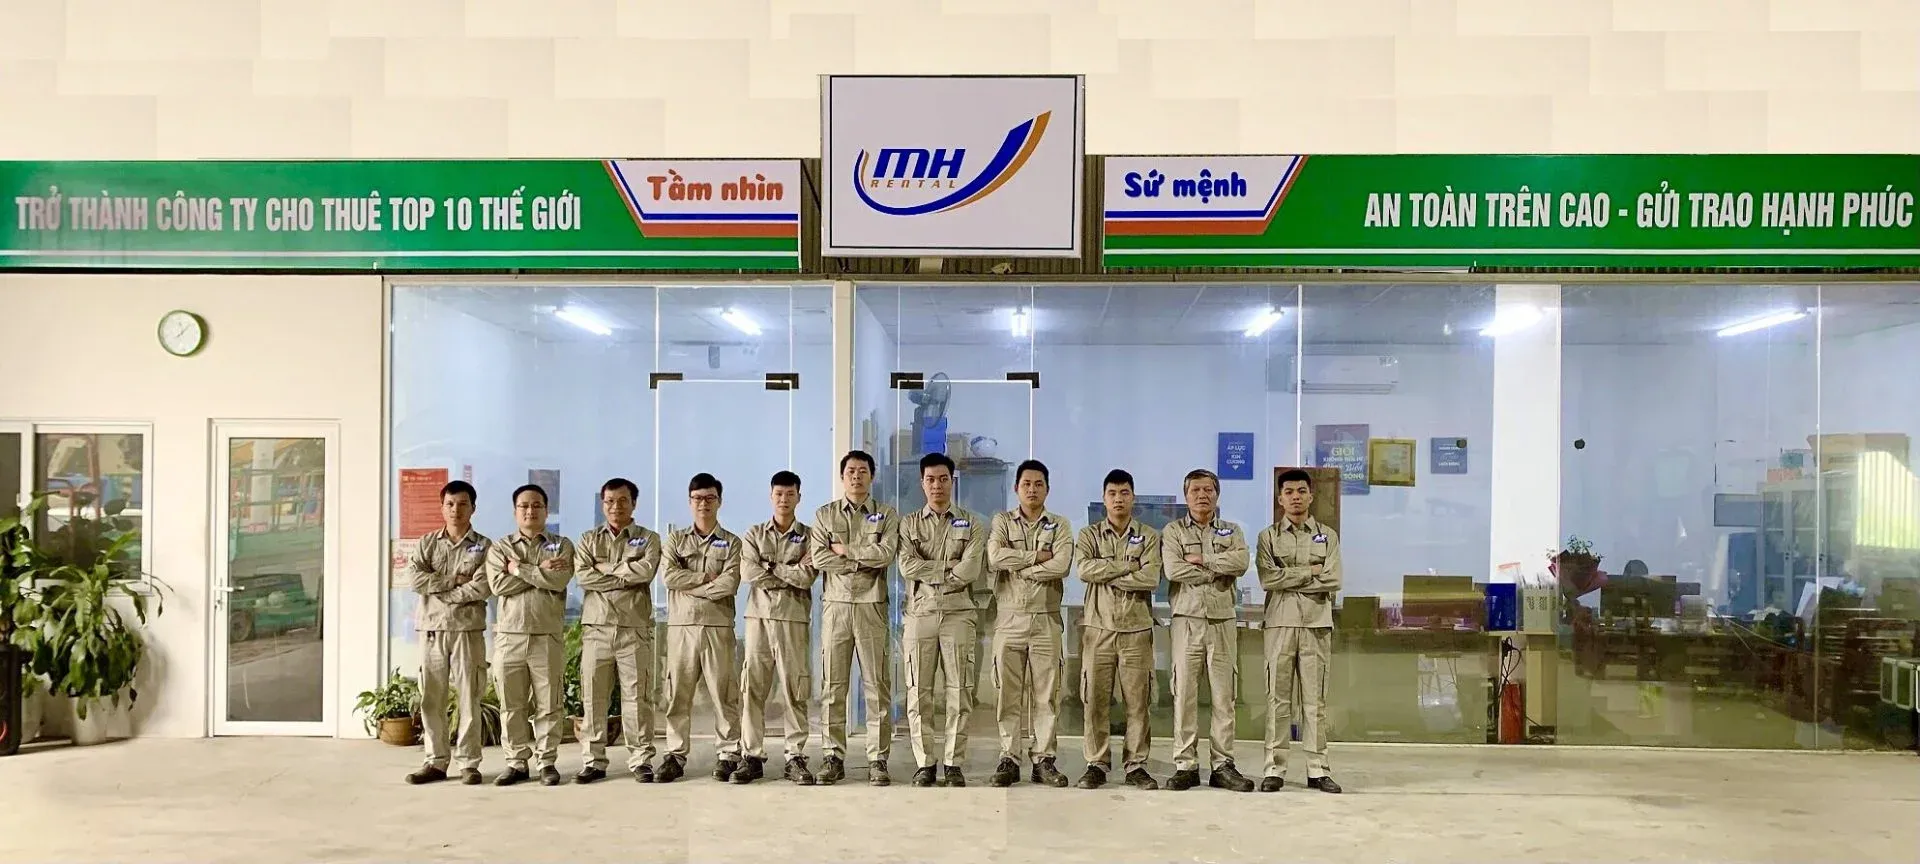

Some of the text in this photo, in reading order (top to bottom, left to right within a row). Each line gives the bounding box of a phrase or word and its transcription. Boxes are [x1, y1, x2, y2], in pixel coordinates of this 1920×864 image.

[873, 148, 966, 179] MH
[647, 168, 784, 201] Tầm nhìn
[870, 179, 956, 189] RENTAL
[1125, 169, 1247, 204] Sứ mệnh
[15, 185, 581, 232] TRỞ THÀNH CÔNG TY CHO THUÊ TOP 10 THẾ GIỚI
[1364, 193, 1400, 227] AN
[1409, 185, 1477, 227] TOÀN
[1485, 185, 1551, 227] TRÊN
[1559, 192, 1610, 228] CAO
[1636, 181, 1680, 228] GỬI
[1688, 192, 1754, 228] TRAO
[1761, 191, 1835, 236] HẠNH
[1842, 184, 1914, 228] PHÚC
